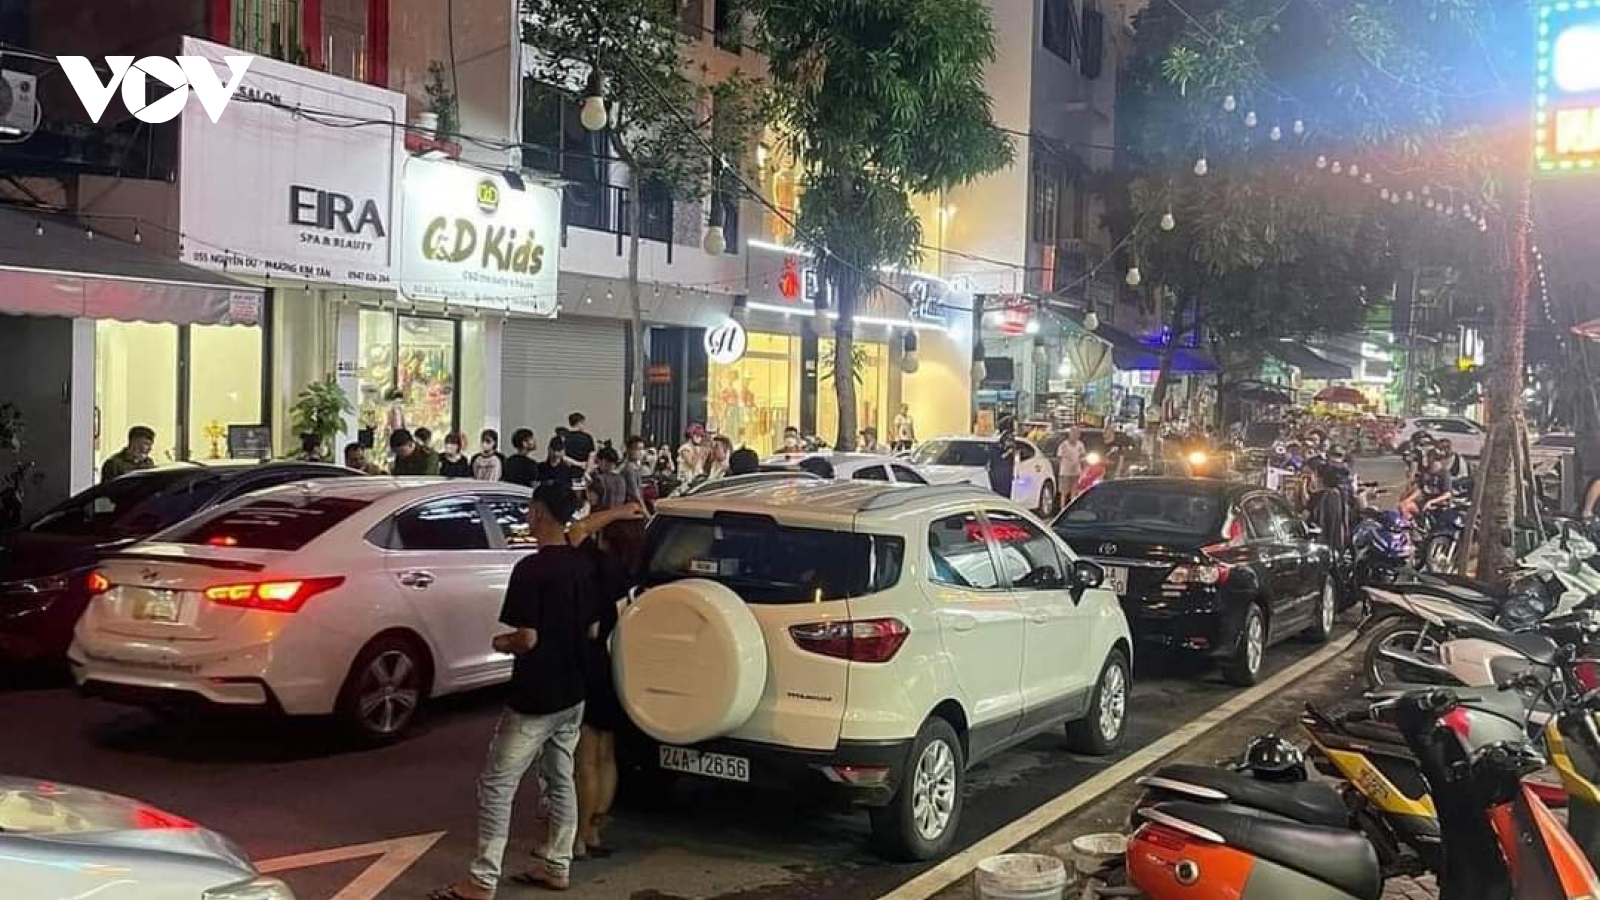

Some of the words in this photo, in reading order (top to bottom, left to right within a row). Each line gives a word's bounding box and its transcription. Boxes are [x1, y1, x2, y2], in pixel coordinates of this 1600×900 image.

[289, 185, 385, 237] EIRA
[300, 233, 321, 244] SPA
[333, 237, 372, 250] BEAUTY
